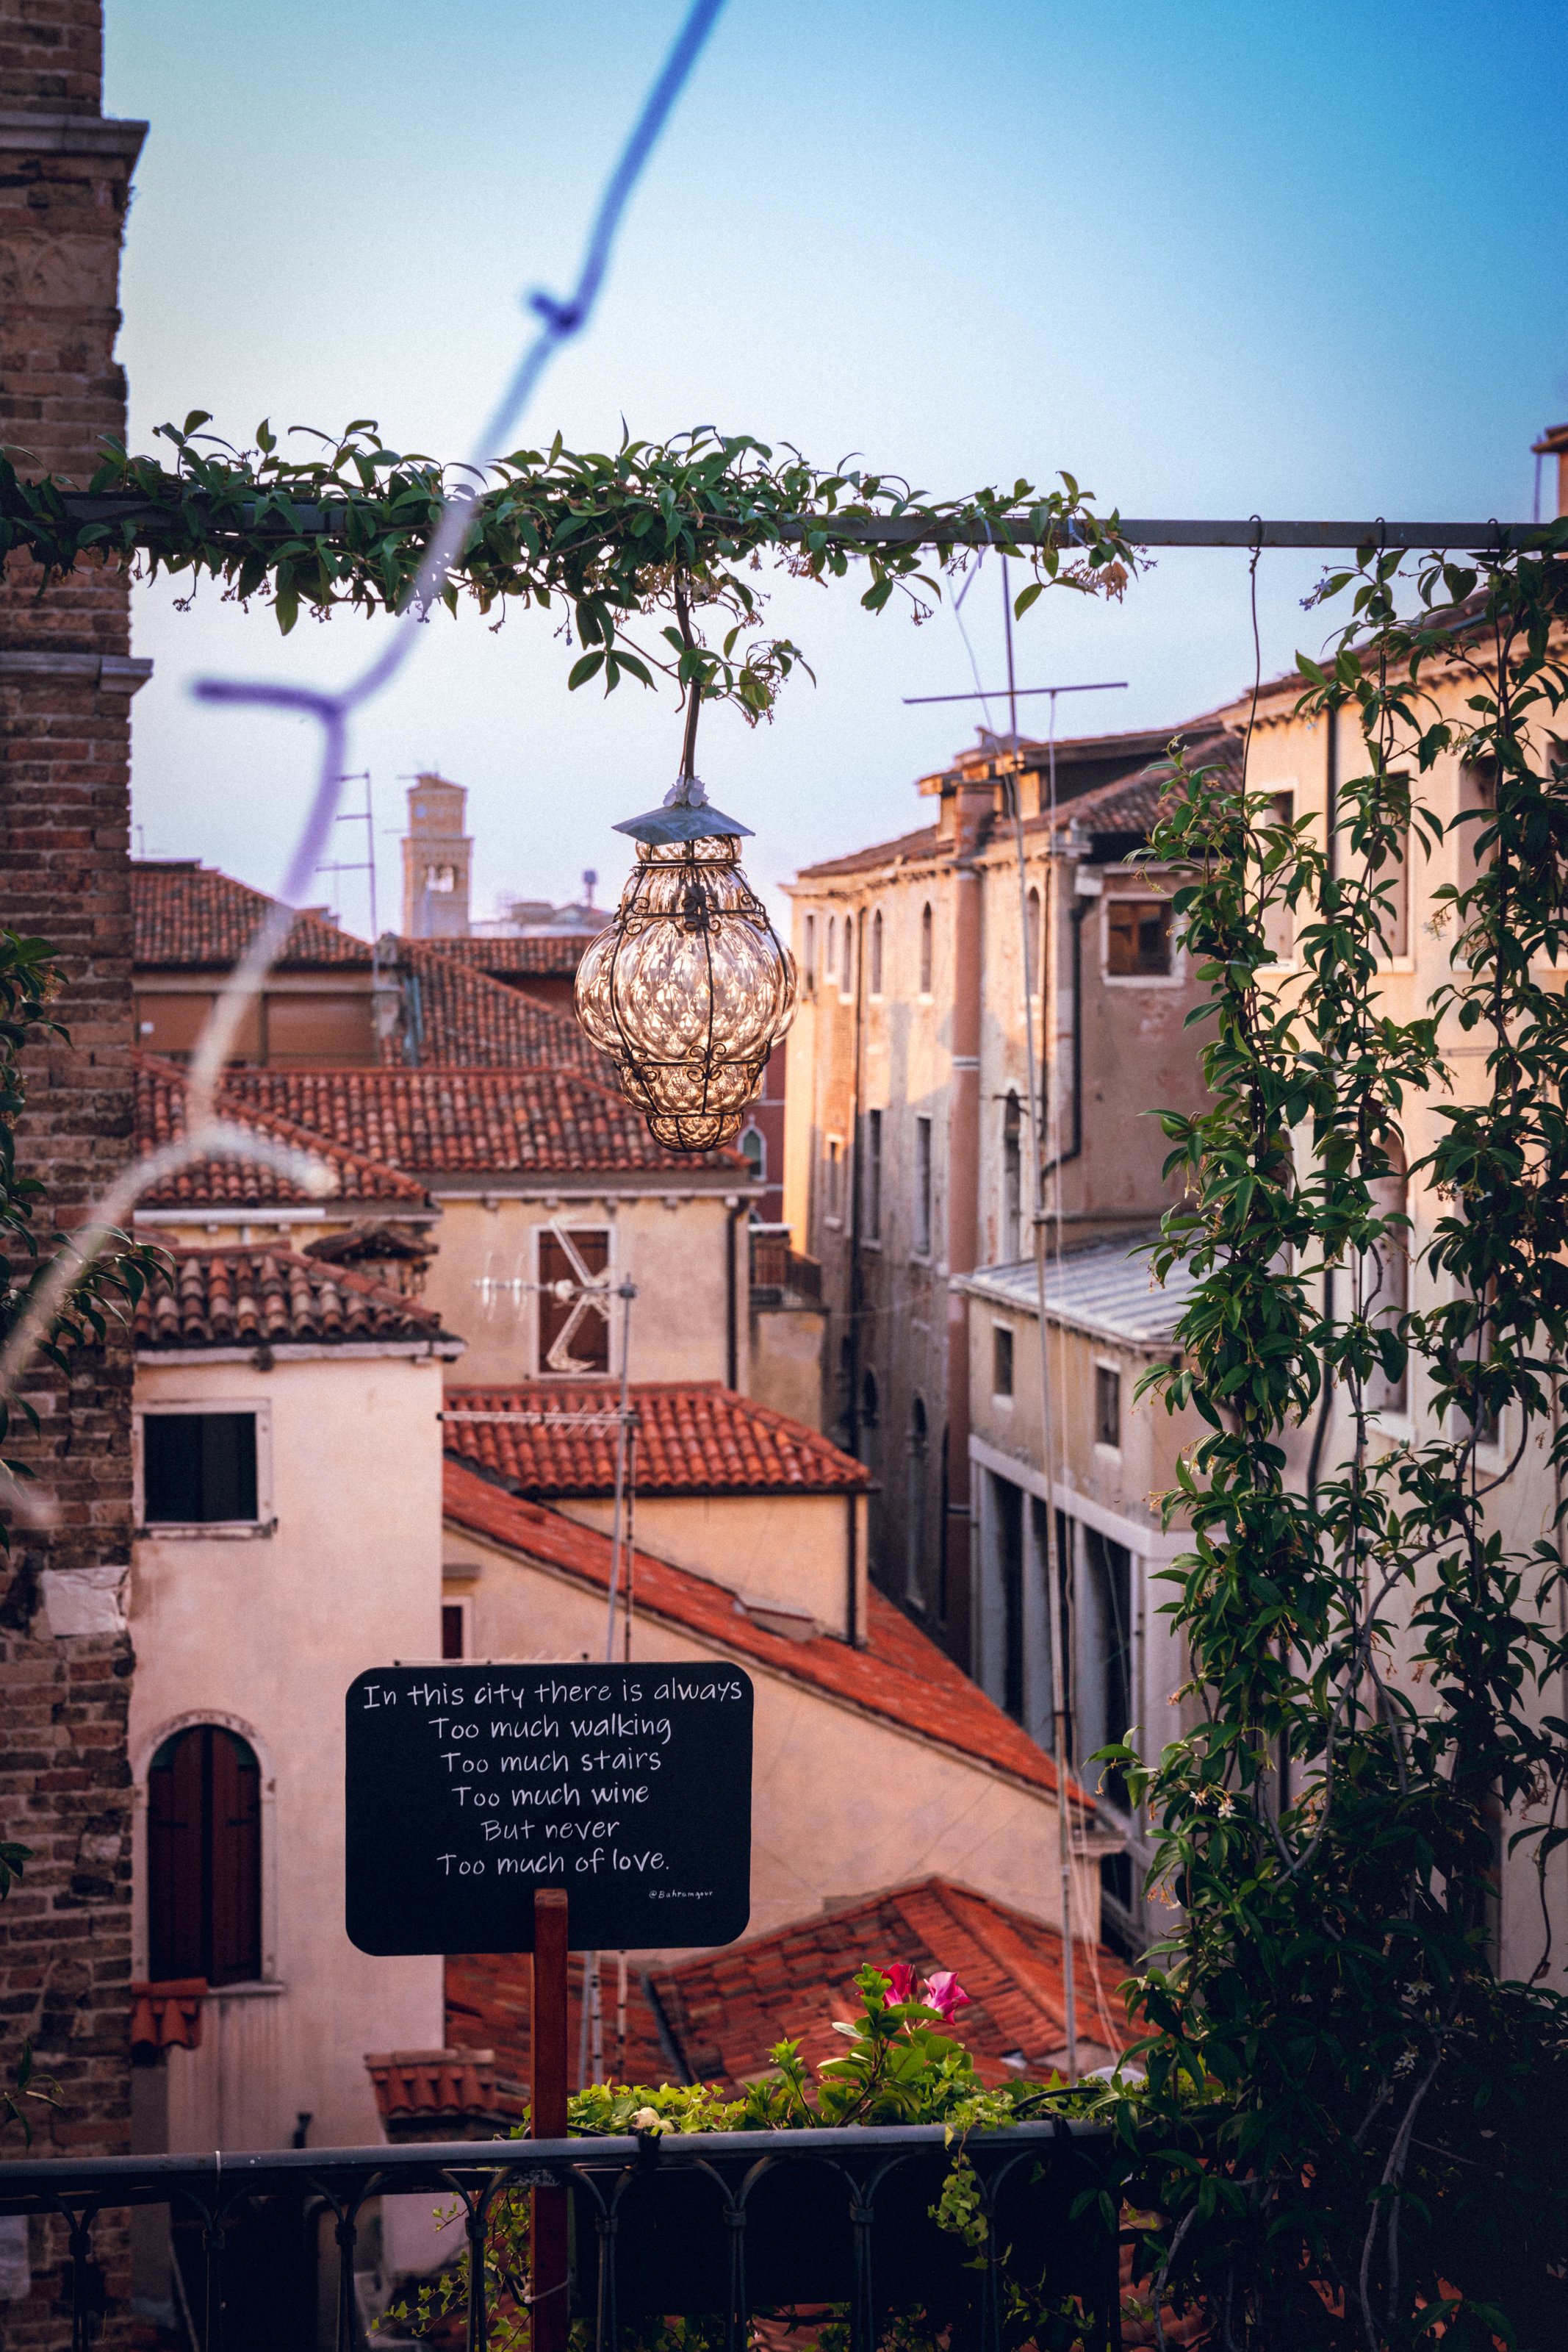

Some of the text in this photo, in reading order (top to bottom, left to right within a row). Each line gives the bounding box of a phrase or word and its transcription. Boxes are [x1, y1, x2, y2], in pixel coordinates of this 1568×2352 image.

[363, 1677, 744, 1710] In this city there is always
[428, 1713, 672, 1746] Too much walking
[440, 1749, 662, 1774] Too much stairs
[451, 1782, 650, 1807] Too much wine
[481, 1820, 621, 1841] But never
[436, 1847, 671, 1876] Too much of love.
